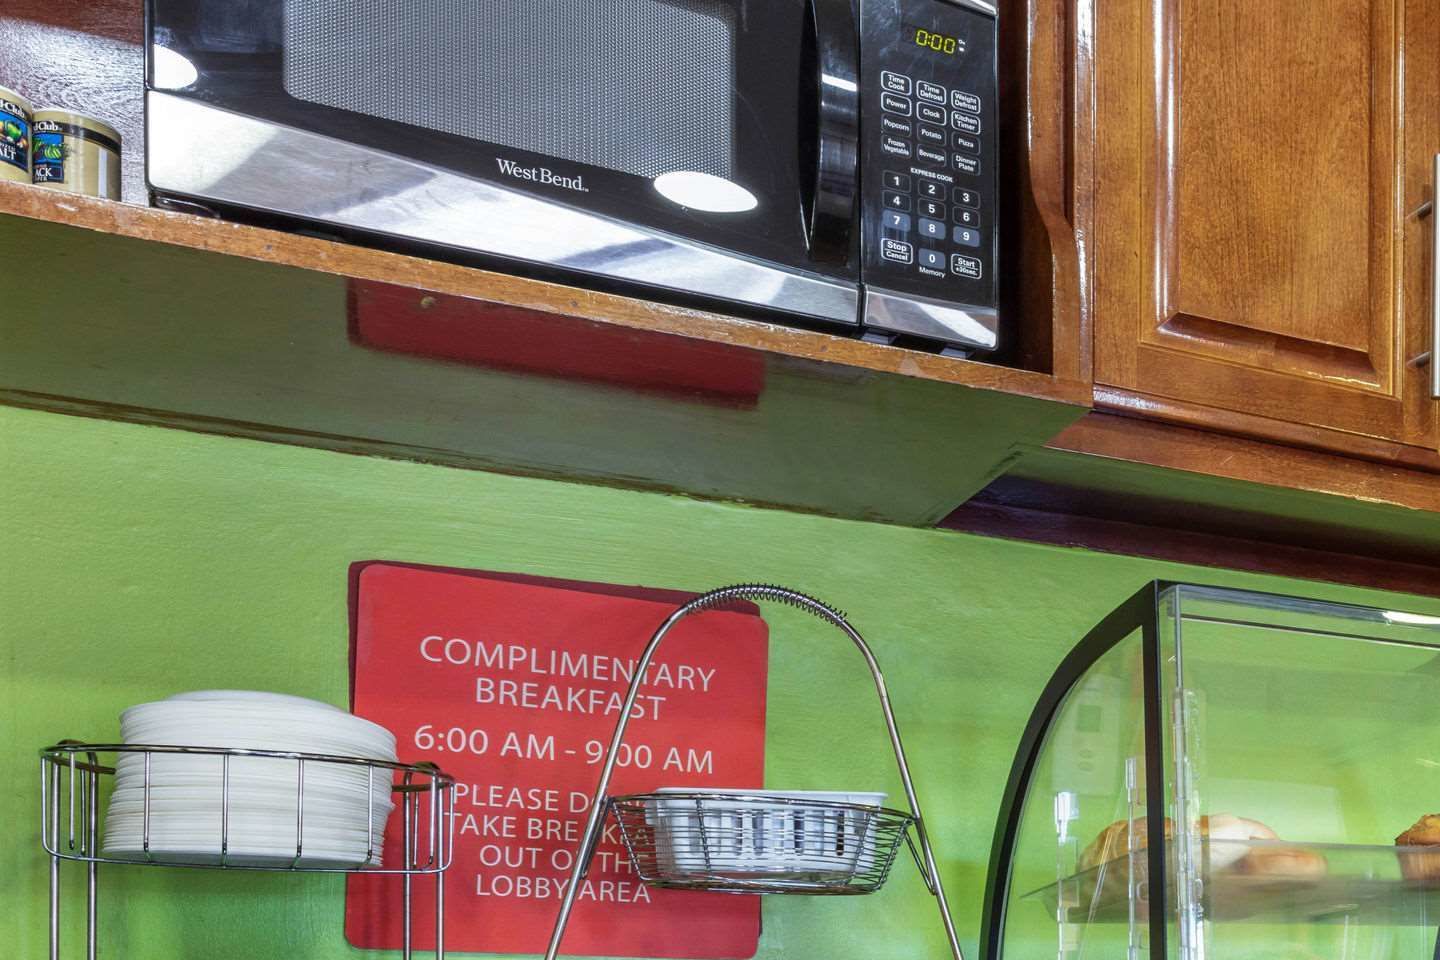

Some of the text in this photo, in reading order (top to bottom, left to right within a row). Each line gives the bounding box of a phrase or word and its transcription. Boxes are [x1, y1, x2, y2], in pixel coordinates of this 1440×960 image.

[916, 30, 956, 54] 0:00
[888, 74, 904, 84] Time
[888, 82, 904, 91] Cook
[924, 84, 940, 94] Time
[920, 90, 943, 101] Defrost
[955, 93, 976, 104] Weight
[886, 98, 907, 109] Power
[955, 100, 977, 111] Defrost
[923, 108, 940, 118] Clock
[884, 119, 910, 131] Popcorn
[955, 114, 978, 125] Kitchen
[957, 121, 976, 130] Timer
[922, 129, 942, 140] Potato
[888, 138, 906, 148] Frozen
[884, 144, 910, 156] Vegetable
[919, 149, 945, 162] Beverage
[956, 155, 976, 166] Dinner
[496, 158, 538, 181] West
[958, 163, 974, 172] Plate
[910, 167, 953, 183] EXPRESS COOK
[894, 176, 900, 186] 1
[928, 185, 936, 194] 2
[893, 196, 900, 205] 4
[962, 193, 970, 202] 3
[928, 204, 936, 214] 5
[893, 216, 900, 225] 7
[962, 212, 970, 222] 6
[928, 224, 936, 233] 8
[962, 232, 970, 241] 9
[887, 241, 907, 252] Stop
[886, 250, 908, 261] Cancel
[928, 254, 936, 264] 0
[958, 258, 976, 268] Start
[919, 266, 946, 278] Memory
[420, 635, 716, 692] COMPLIMENTARY
[476, 678, 666, 721] BREAKFAST
[414, 724, 488, 754] 6:00
[500, 731, 554, 761] AM
[662, 746, 713, 774] AM
[454, 783, 559, 812] PLEASE
[444, 812, 517, 838] TAKE
[480, 844, 543, 869] OUT
[476, 874, 650, 903] LOBBY AREA
